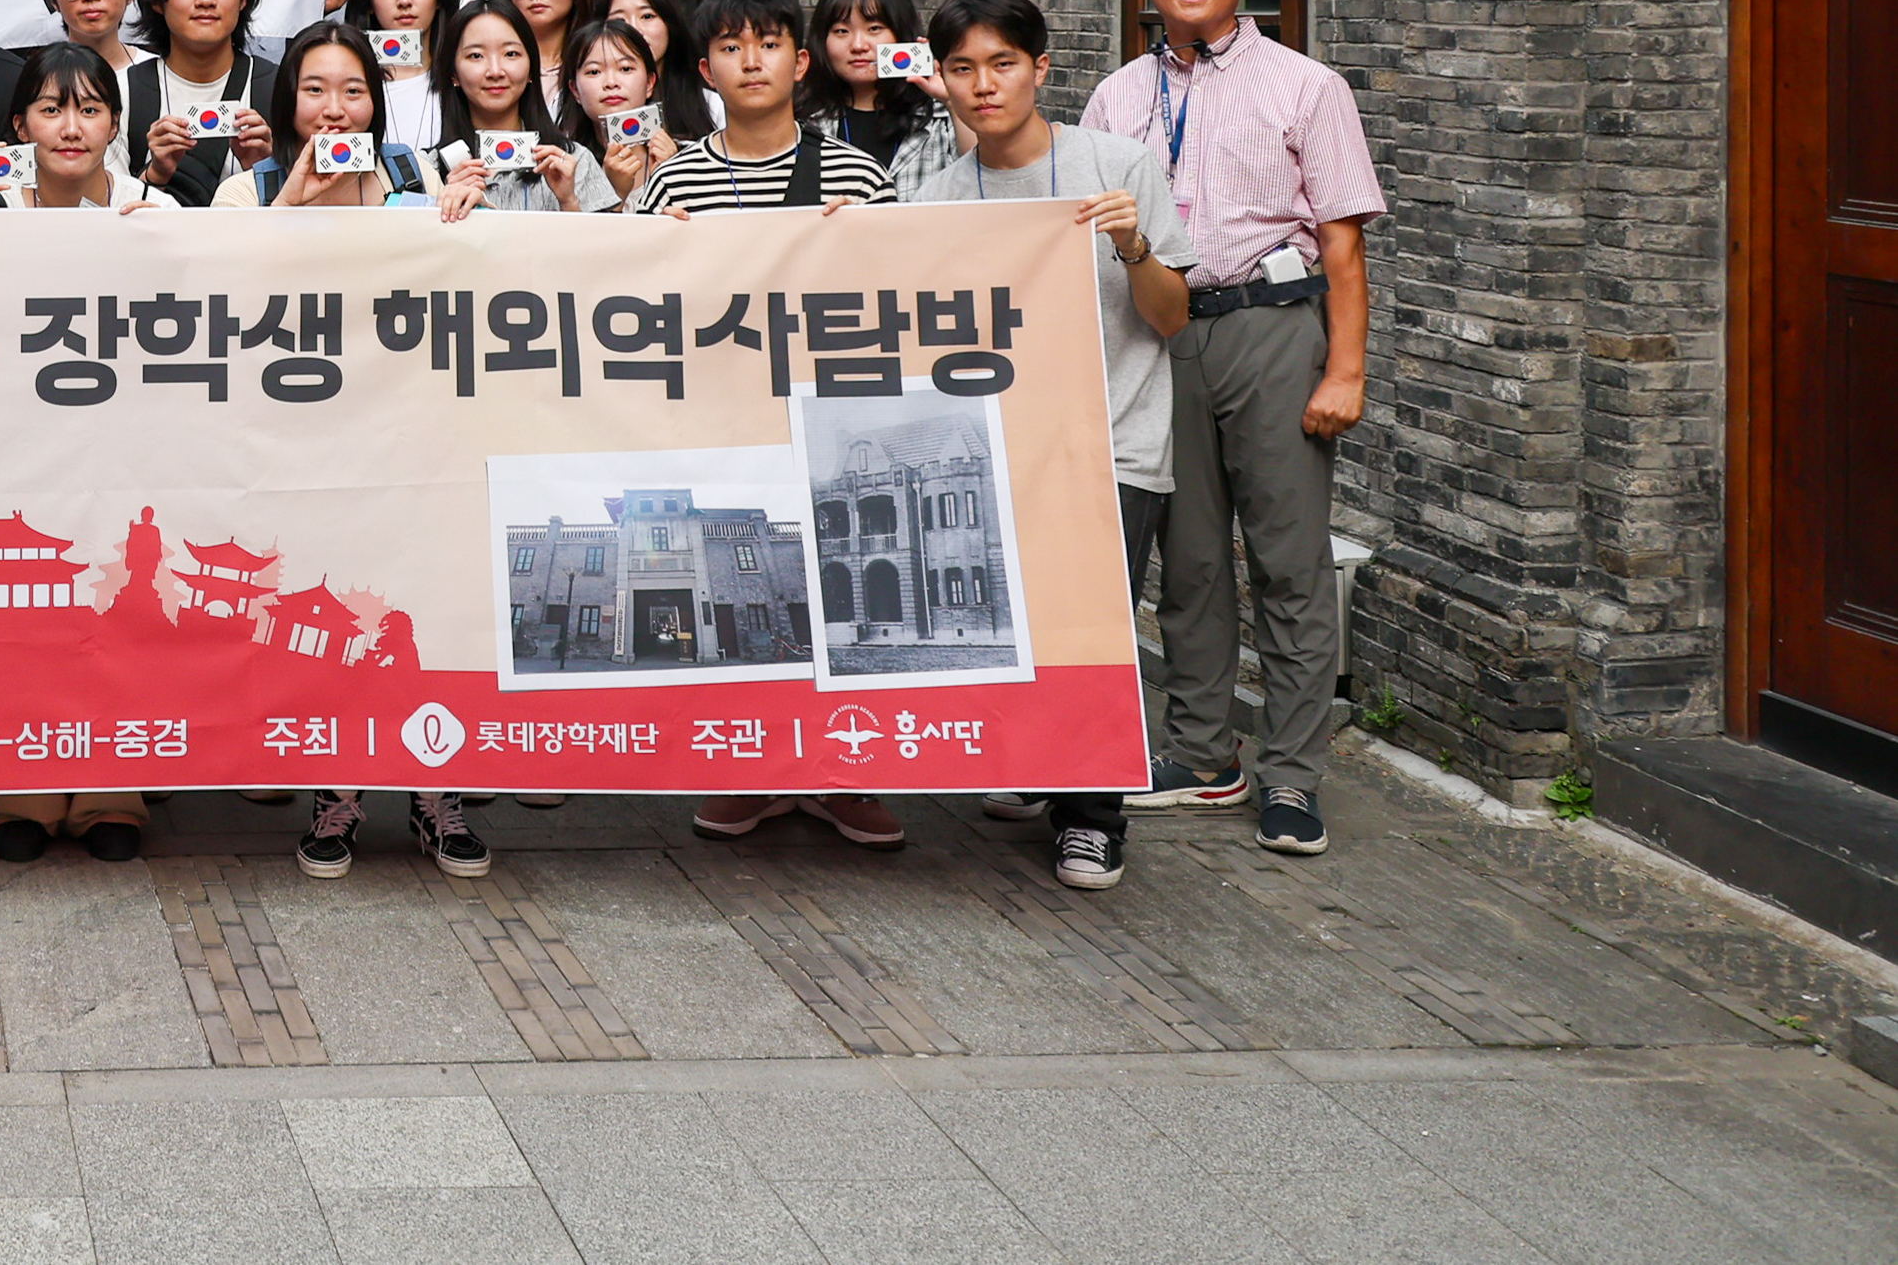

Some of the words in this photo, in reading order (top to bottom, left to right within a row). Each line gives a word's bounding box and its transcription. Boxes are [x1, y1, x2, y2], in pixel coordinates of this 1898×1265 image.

[20, 292, 343, 407] 장학생
[373, 286, 1023, 401] 해외역사탐방
[263, 717, 338, 757] 주최
[476, 721, 660, 754] 롯데장학재단
[691, 718, 767, 760] 주관
[894, 710, 984, 759] 흥사단
